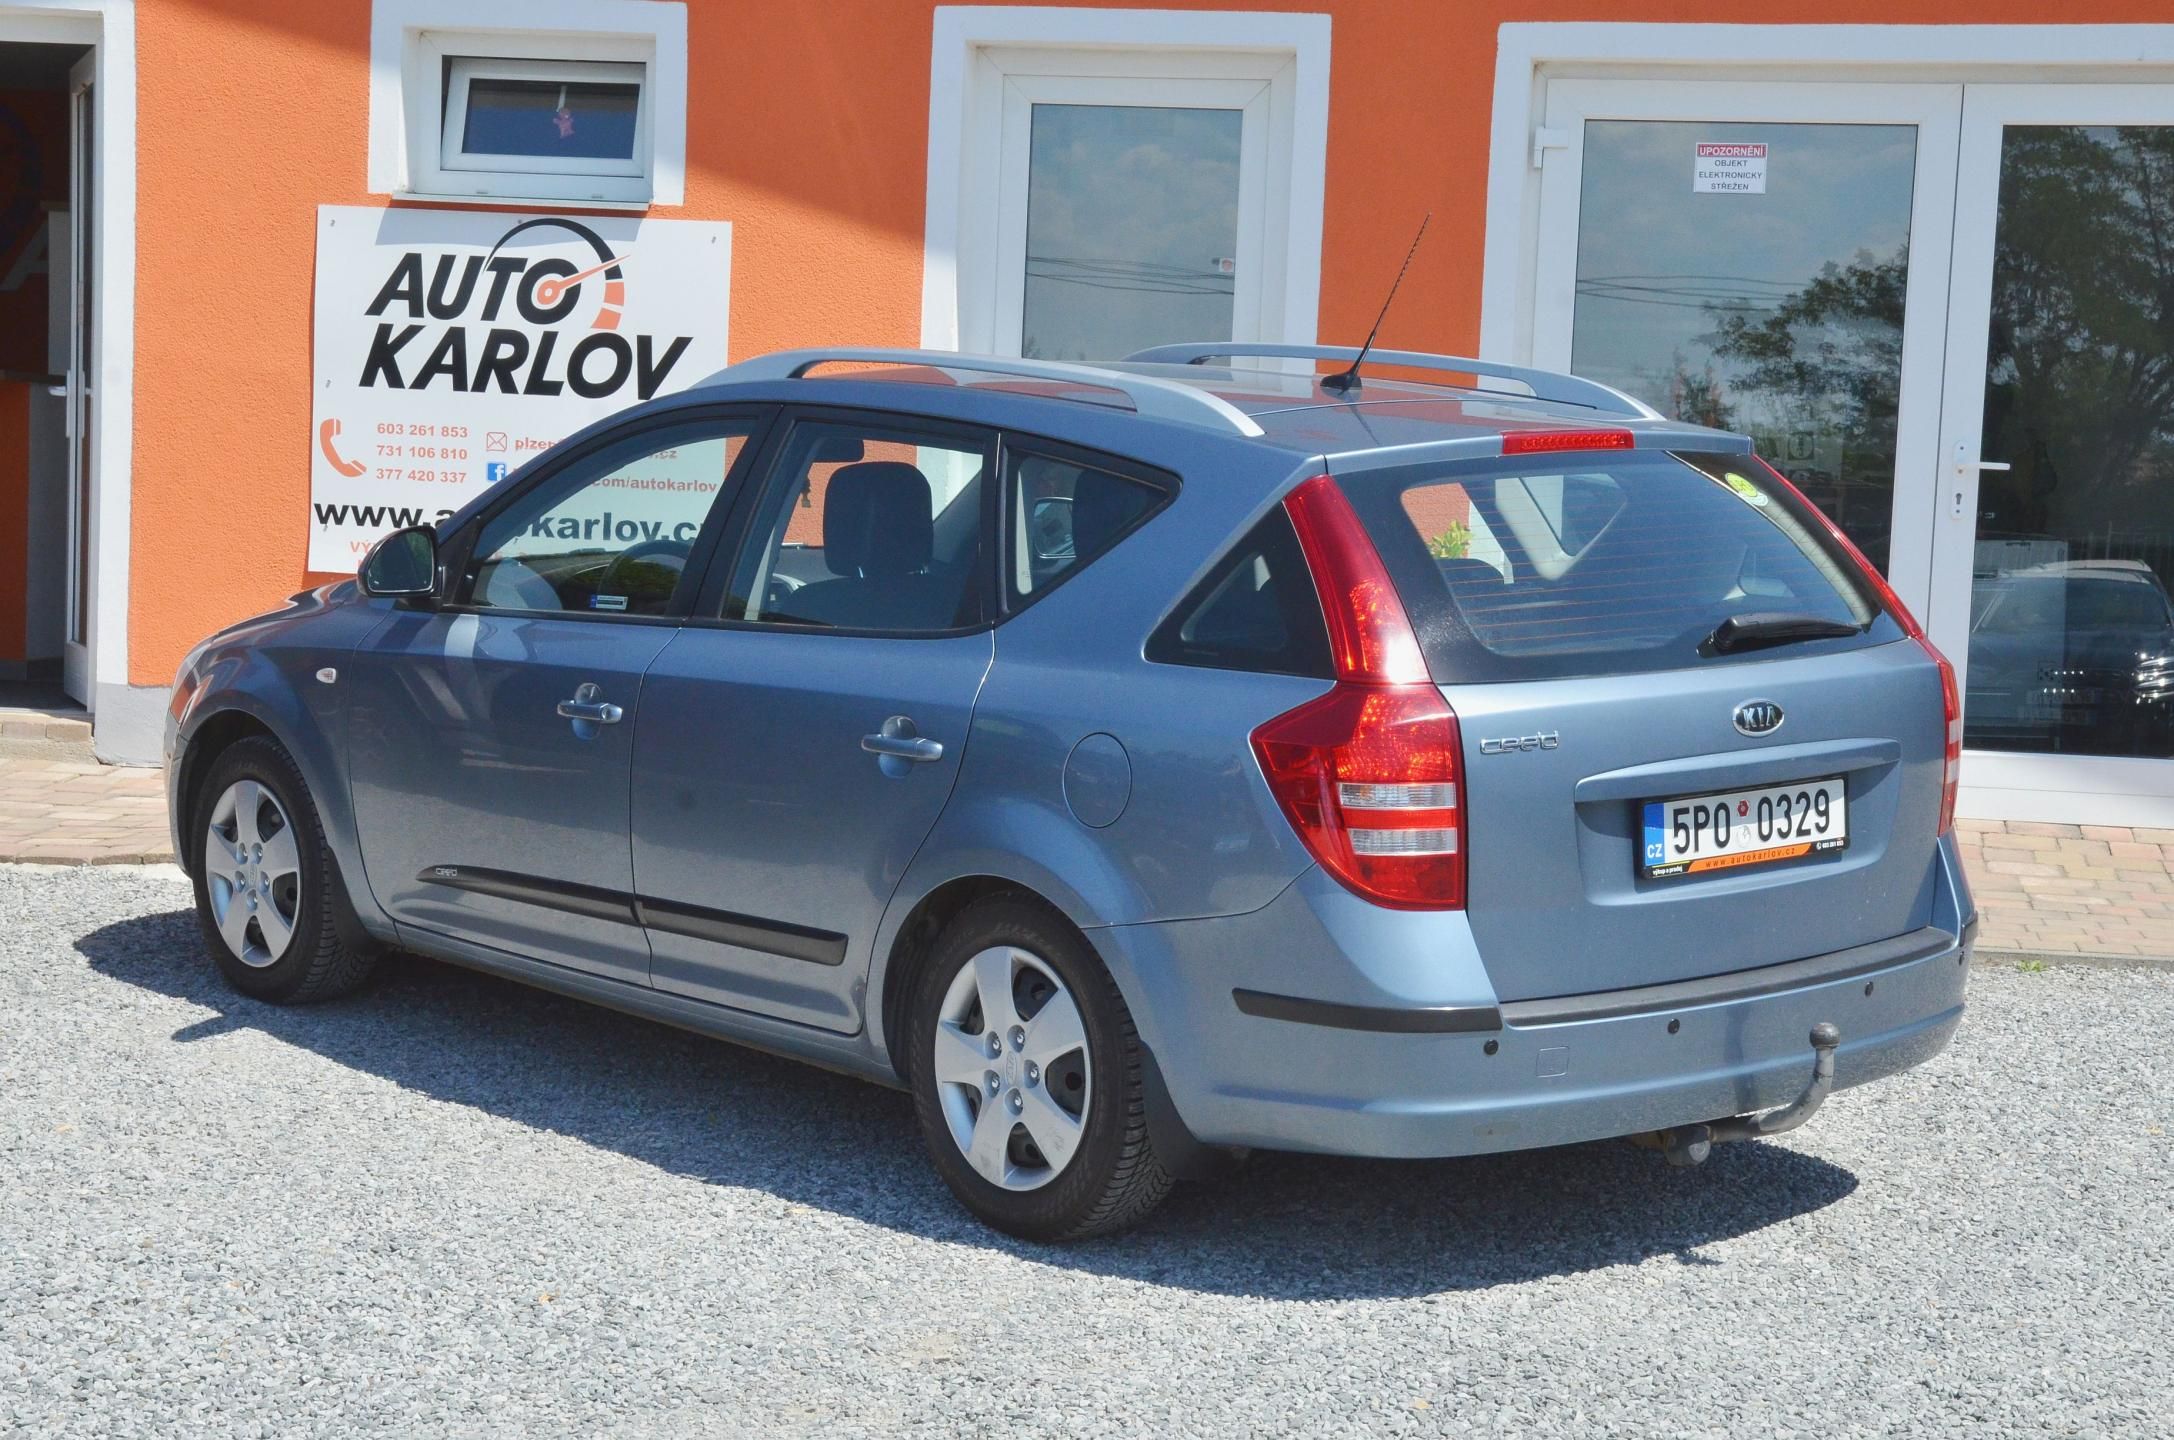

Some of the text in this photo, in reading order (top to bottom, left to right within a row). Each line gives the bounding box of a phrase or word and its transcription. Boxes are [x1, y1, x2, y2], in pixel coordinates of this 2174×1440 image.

[1699, 145, 1763, 157] UPOZORNĚNÍ
[1714, 159, 1748, 167] OBJEKT
[1698, 171, 1762, 179] ELEKTRONICKY
[1710, 182, 1749, 190] STŘEŽEN
[364, 252, 581, 325] AUTO
[359, 323, 693, 400] KARLOV
[377, 422, 468, 438] 603 261 853
[376, 445, 468, 460] 731 106 810
[376, 467, 467, 484] 377 420 337
[1742, 705, 1777, 728] KIA
[1757, 788, 1830, 842] 0329
[1647, 844, 1663, 859] CZ
